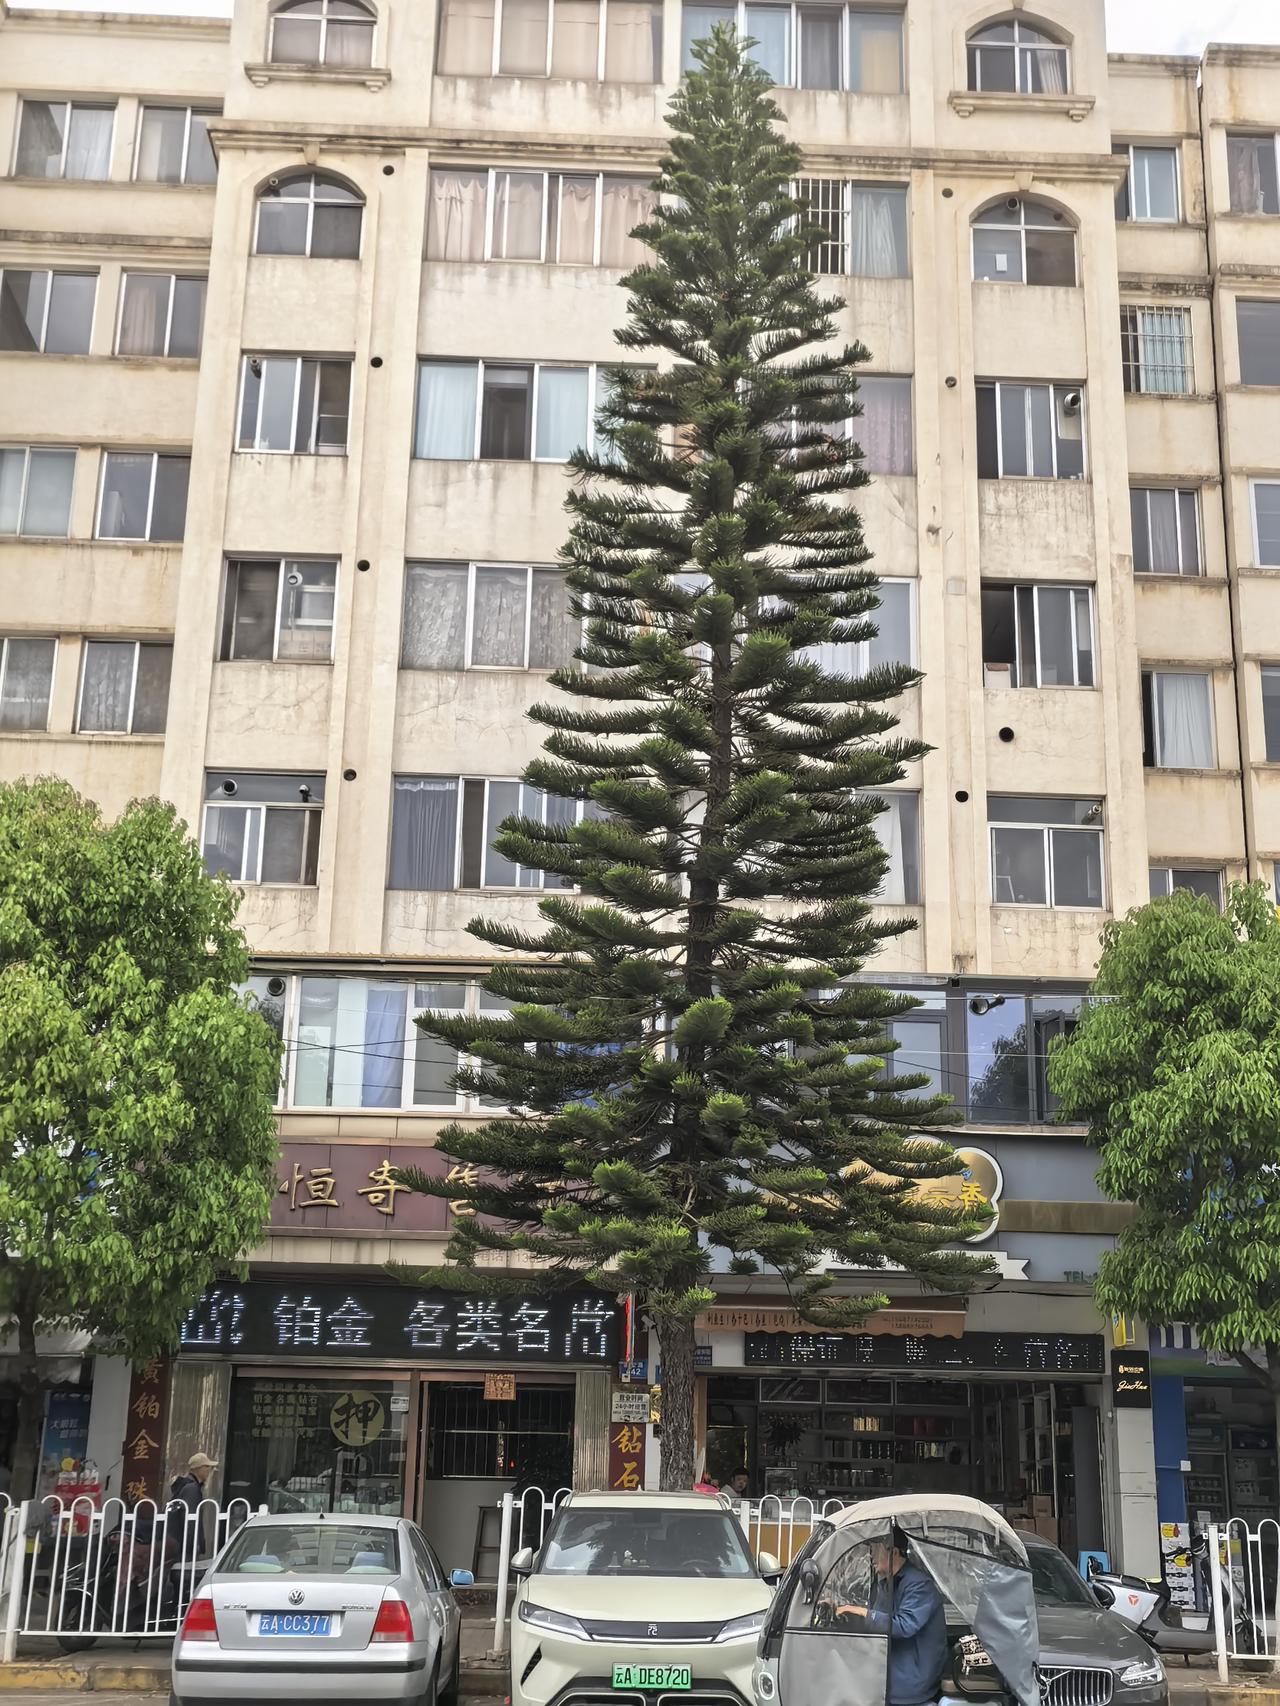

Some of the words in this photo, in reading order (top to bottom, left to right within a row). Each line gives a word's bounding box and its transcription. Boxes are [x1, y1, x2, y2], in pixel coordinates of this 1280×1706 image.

[273, 1296, 375, 1346] 铂金
[334, 1393, 381, 1444] 押
[611, 1425, 642, 1488] 钻石
